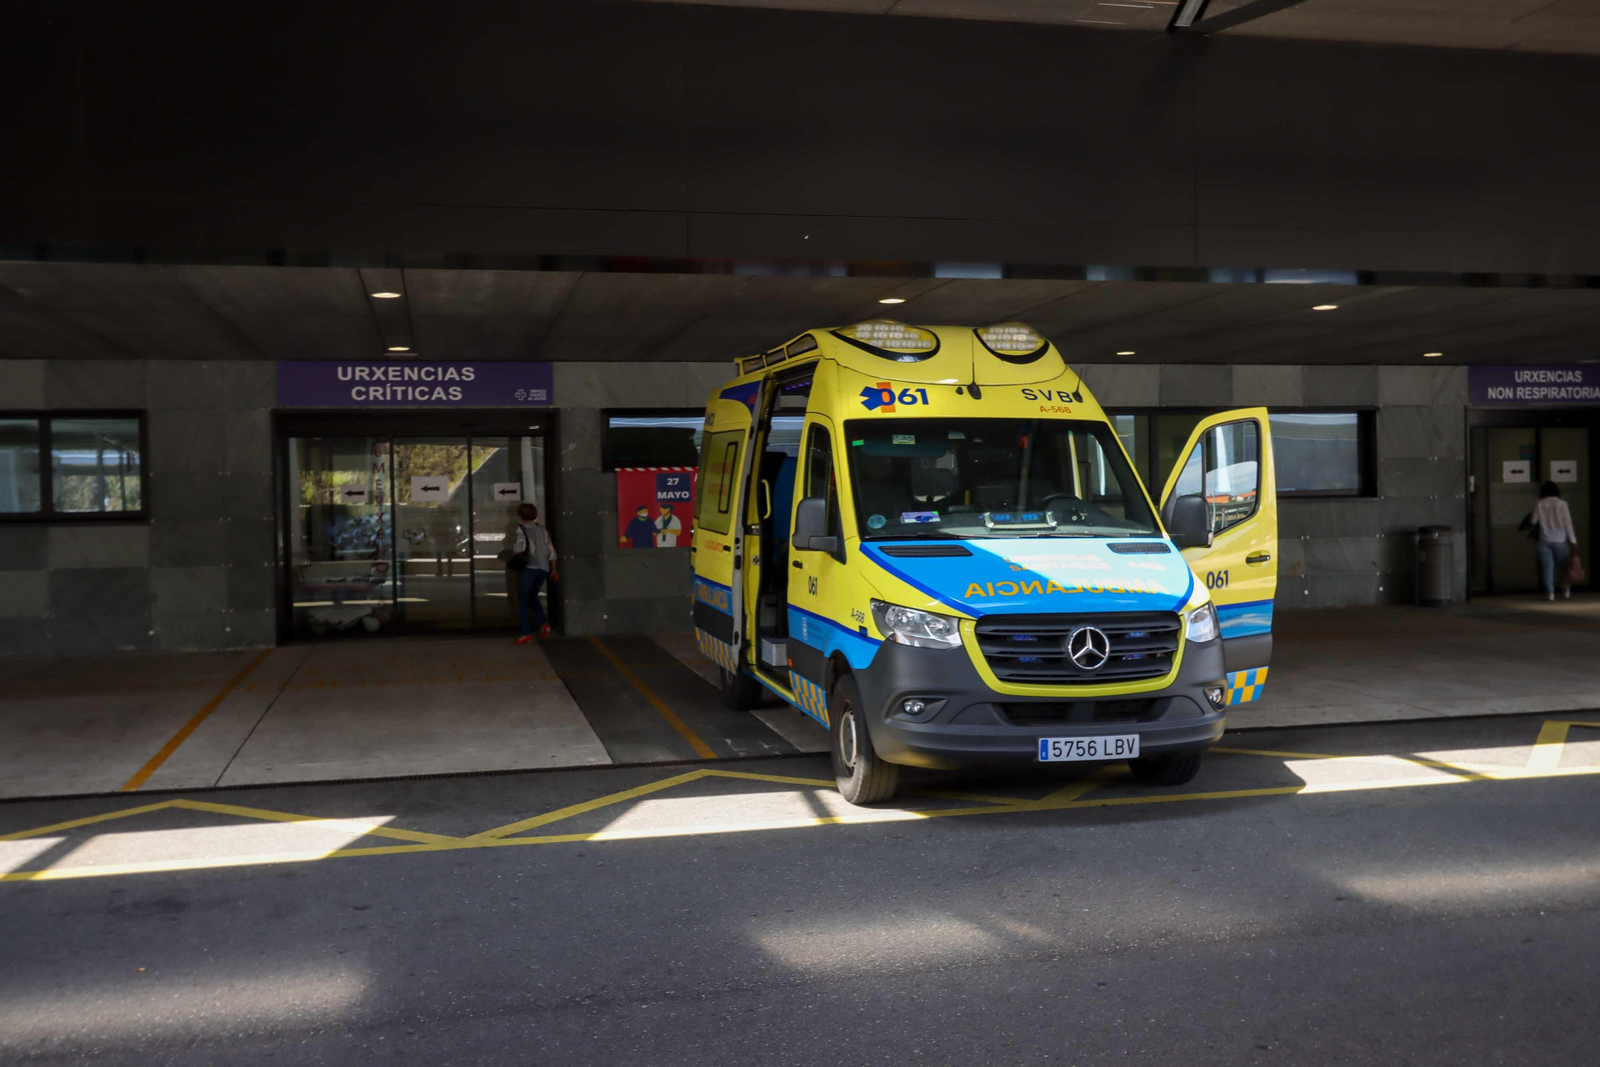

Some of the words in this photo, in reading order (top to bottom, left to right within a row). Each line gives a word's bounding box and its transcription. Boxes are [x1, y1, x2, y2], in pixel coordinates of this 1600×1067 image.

[336, 365, 476, 382] URXENCIAS
[1514, 370, 1583, 383] URXENCIAS
[350, 383, 463, 402] CRÍTICAS
[879, 388, 929, 406] 061
[1487, 387, 1514, 399] NON
[1039, 405, 1072, 413] A-568
[666, 477, 680, 486] 27
[657, 490, 690, 499] MAYO
[1206, 570, 1229, 590] 061
[1052, 740, 1097, 757] 5756
[1104, 738, 1135, 756] LBV
